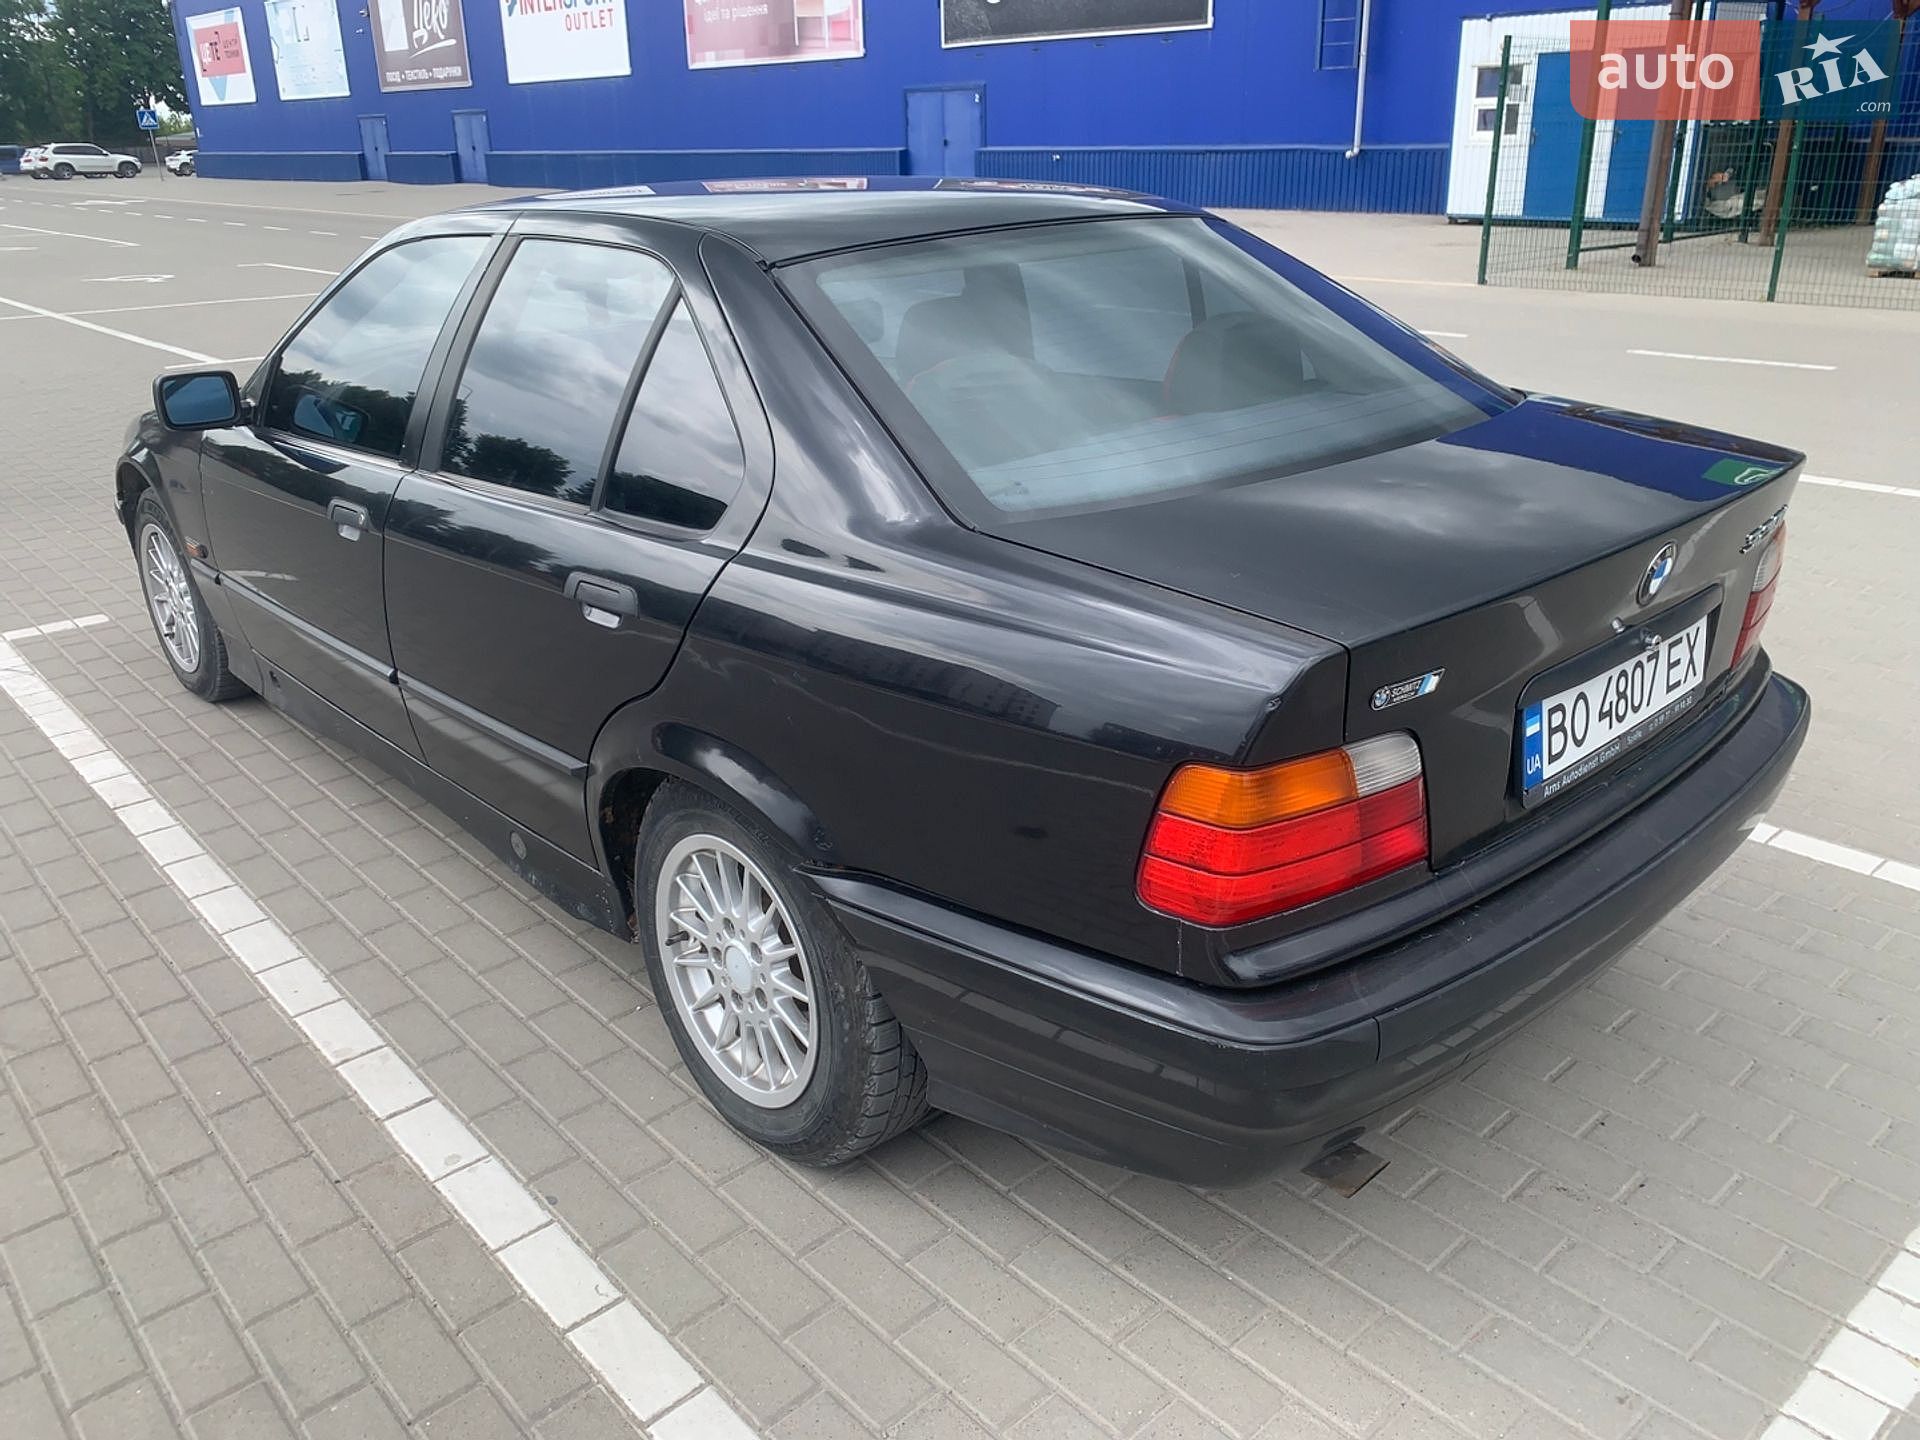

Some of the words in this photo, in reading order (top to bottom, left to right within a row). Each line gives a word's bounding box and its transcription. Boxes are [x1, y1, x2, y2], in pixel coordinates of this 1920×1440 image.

[565, 8, 613, 31] OUTLET
[1547, 692, 1590, 765] BO
[1599, 652, 1660, 730] 4807
[1666, 626, 1701, 695] EX
[1526, 755, 1542, 775] UA
